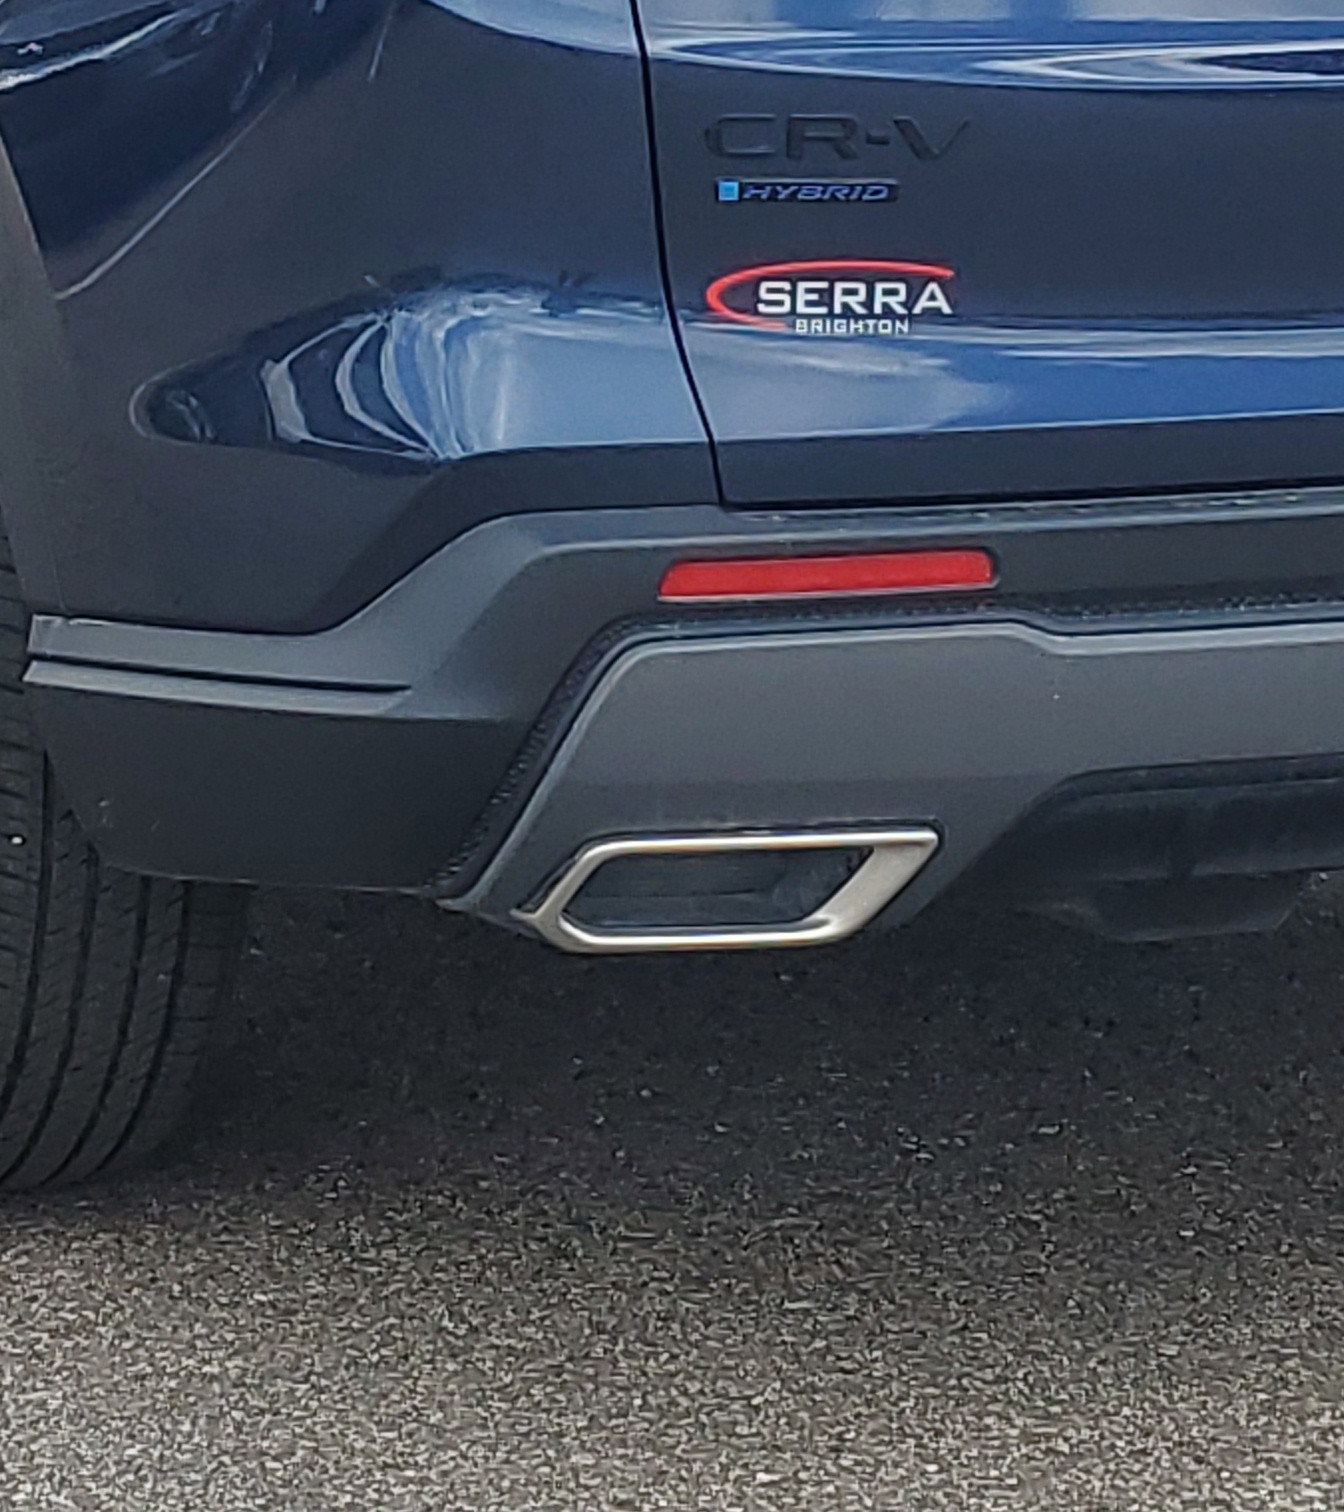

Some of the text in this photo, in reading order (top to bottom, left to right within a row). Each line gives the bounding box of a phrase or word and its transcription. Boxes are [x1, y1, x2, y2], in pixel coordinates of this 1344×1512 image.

[703, 112, 974, 161] CR-V
[742, 184, 890, 202] HYBRID
[756, 279, 954, 315] SERRA
[794, 317, 910, 335] BRIGHTON
